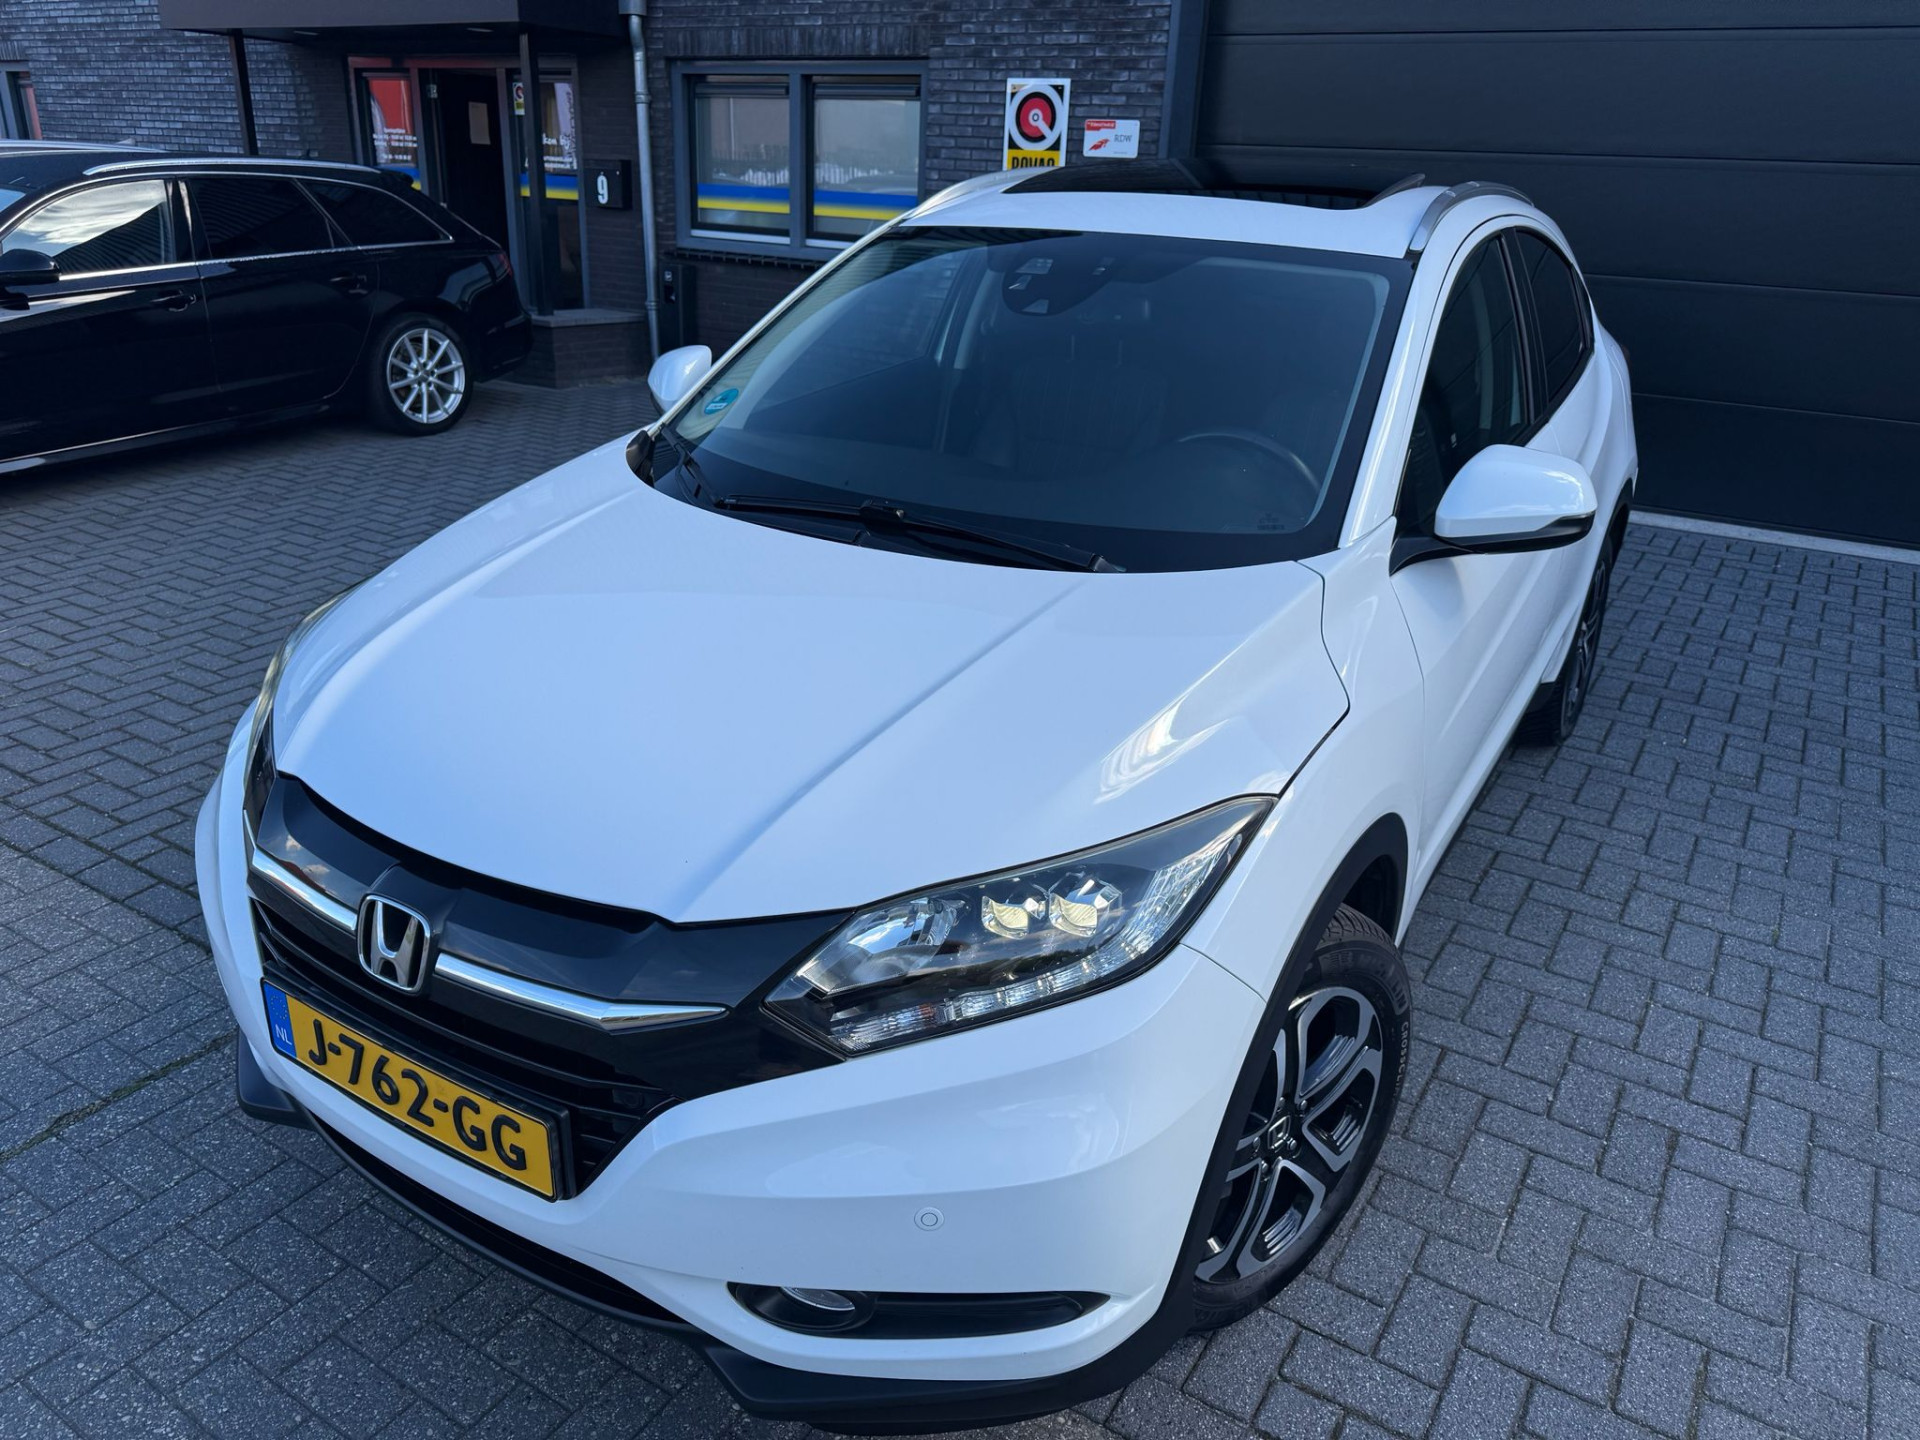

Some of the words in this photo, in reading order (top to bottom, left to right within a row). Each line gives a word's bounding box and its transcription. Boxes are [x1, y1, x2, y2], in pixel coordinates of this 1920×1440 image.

[1114, 134, 1132, 143] RDW
[597, 174, 609, 204] 9
[275, 1023, 292, 1046] NL
[308, 1018, 527, 1171] J-762-GG
